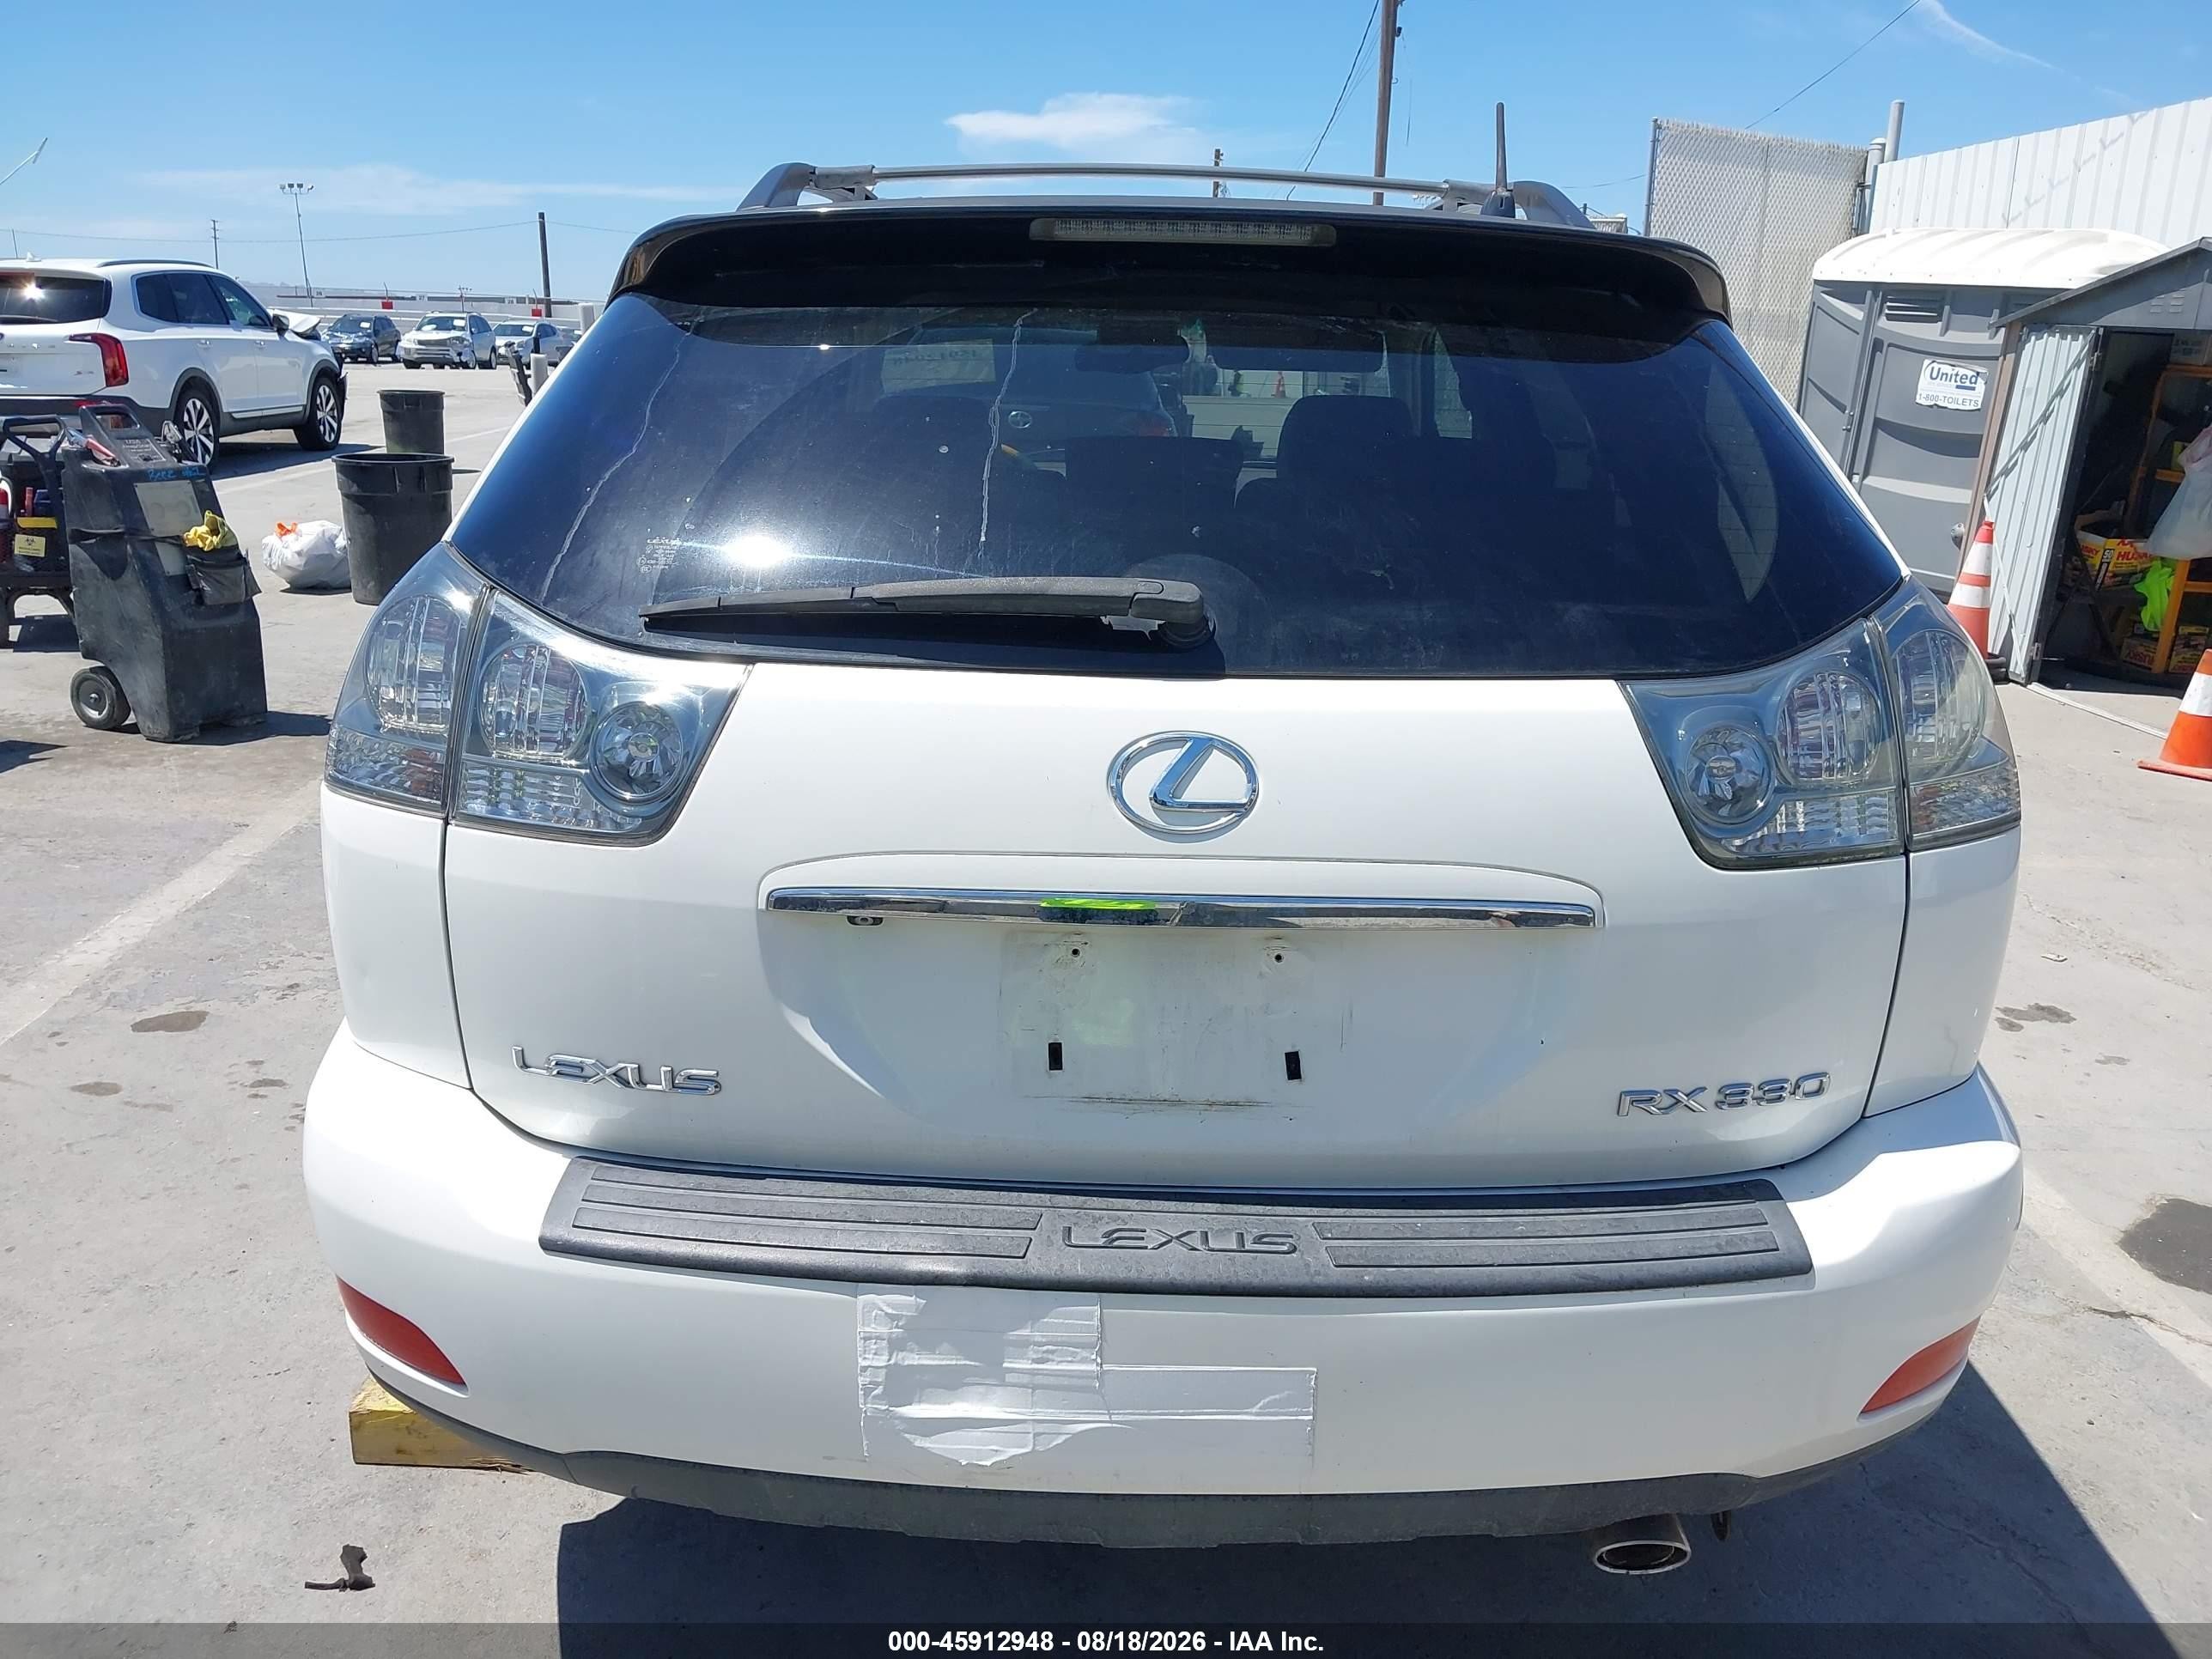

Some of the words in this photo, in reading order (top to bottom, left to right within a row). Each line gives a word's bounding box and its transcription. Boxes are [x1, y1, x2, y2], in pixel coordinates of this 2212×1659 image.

[1929, 367, 1979, 385] United
[1919, 393, 1979, 408] 1-800-TOILETS
[512, 1045, 721, 1096] LEXUS
[1617, 1085, 1709, 1117] RX
[1715, 1072, 1832, 1111] 330
[1061, 1225, 1298, 1255] LEXUS
